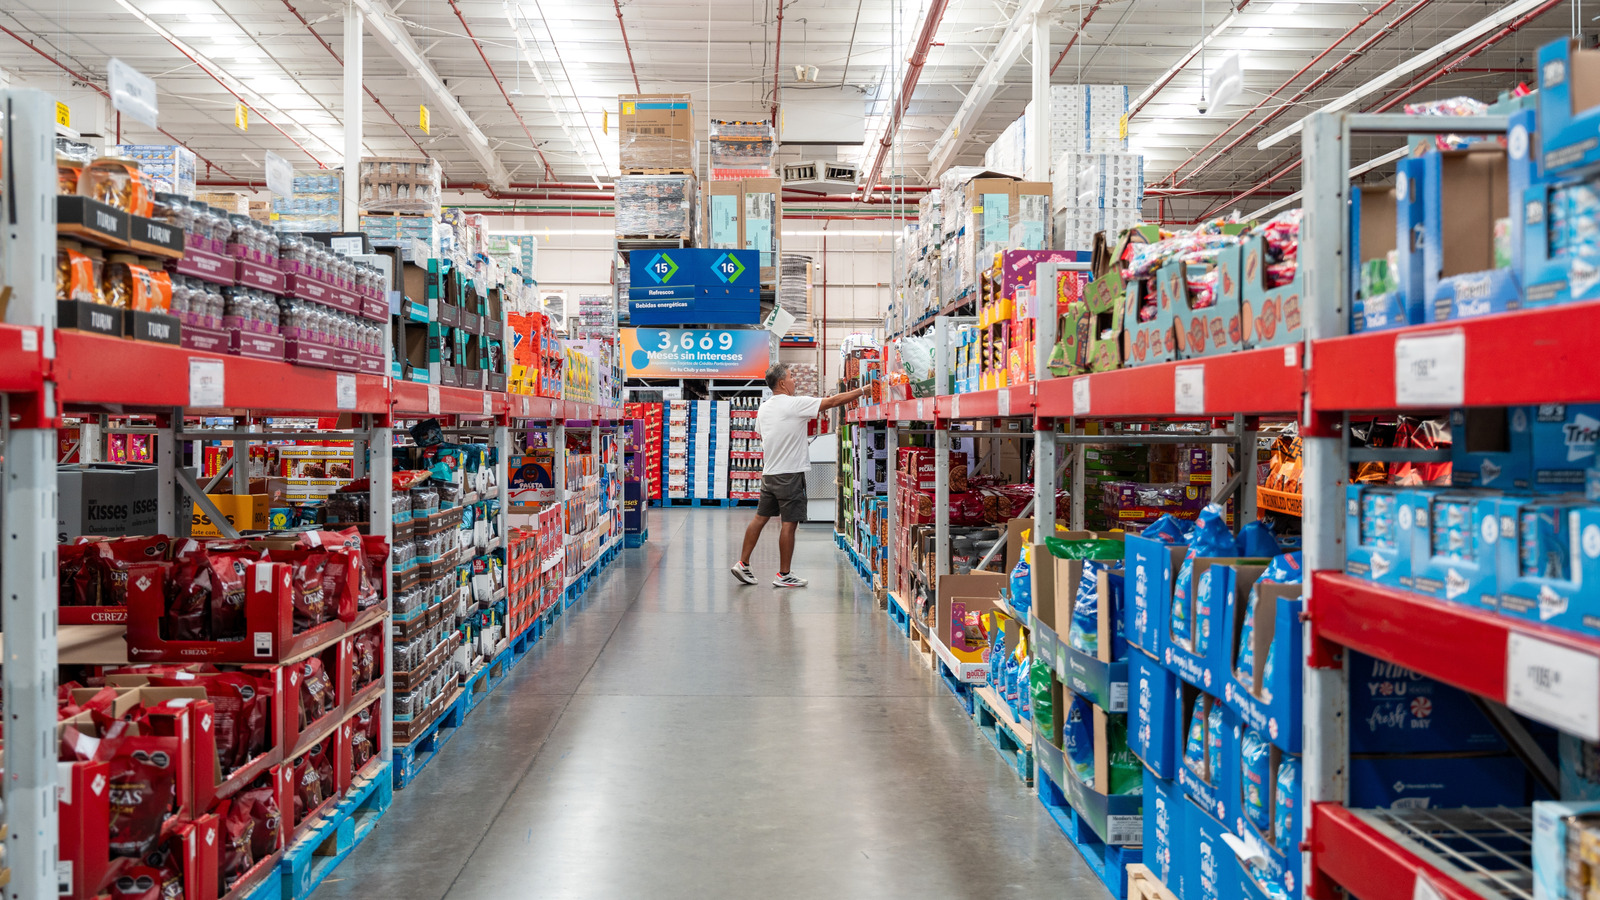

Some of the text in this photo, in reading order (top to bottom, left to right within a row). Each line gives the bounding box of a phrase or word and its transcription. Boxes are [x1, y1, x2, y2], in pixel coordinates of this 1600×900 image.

[96, 210, 118, 232] TURIN
[147, 223, 171, 243] TURIN
[655, 263, 668, 273] 15
[721, 263, 735, 273] 16
[657, 301, 688, 310] energéticas
[91, 311, 113, 331] TURIN
[148, 321, 170, 339] TURIN
[699, 332, 714, 350] ó
[719, 332, 733, 350] 9
[647, 350, 743, 361] Meses sin Intereses
[1566, 425, 1600, 442] Trid
[519, 482, 544, 490] PALETA
[1188, 488, 1196, 496] 14
[91, 612, 128, 622] CEREZA
